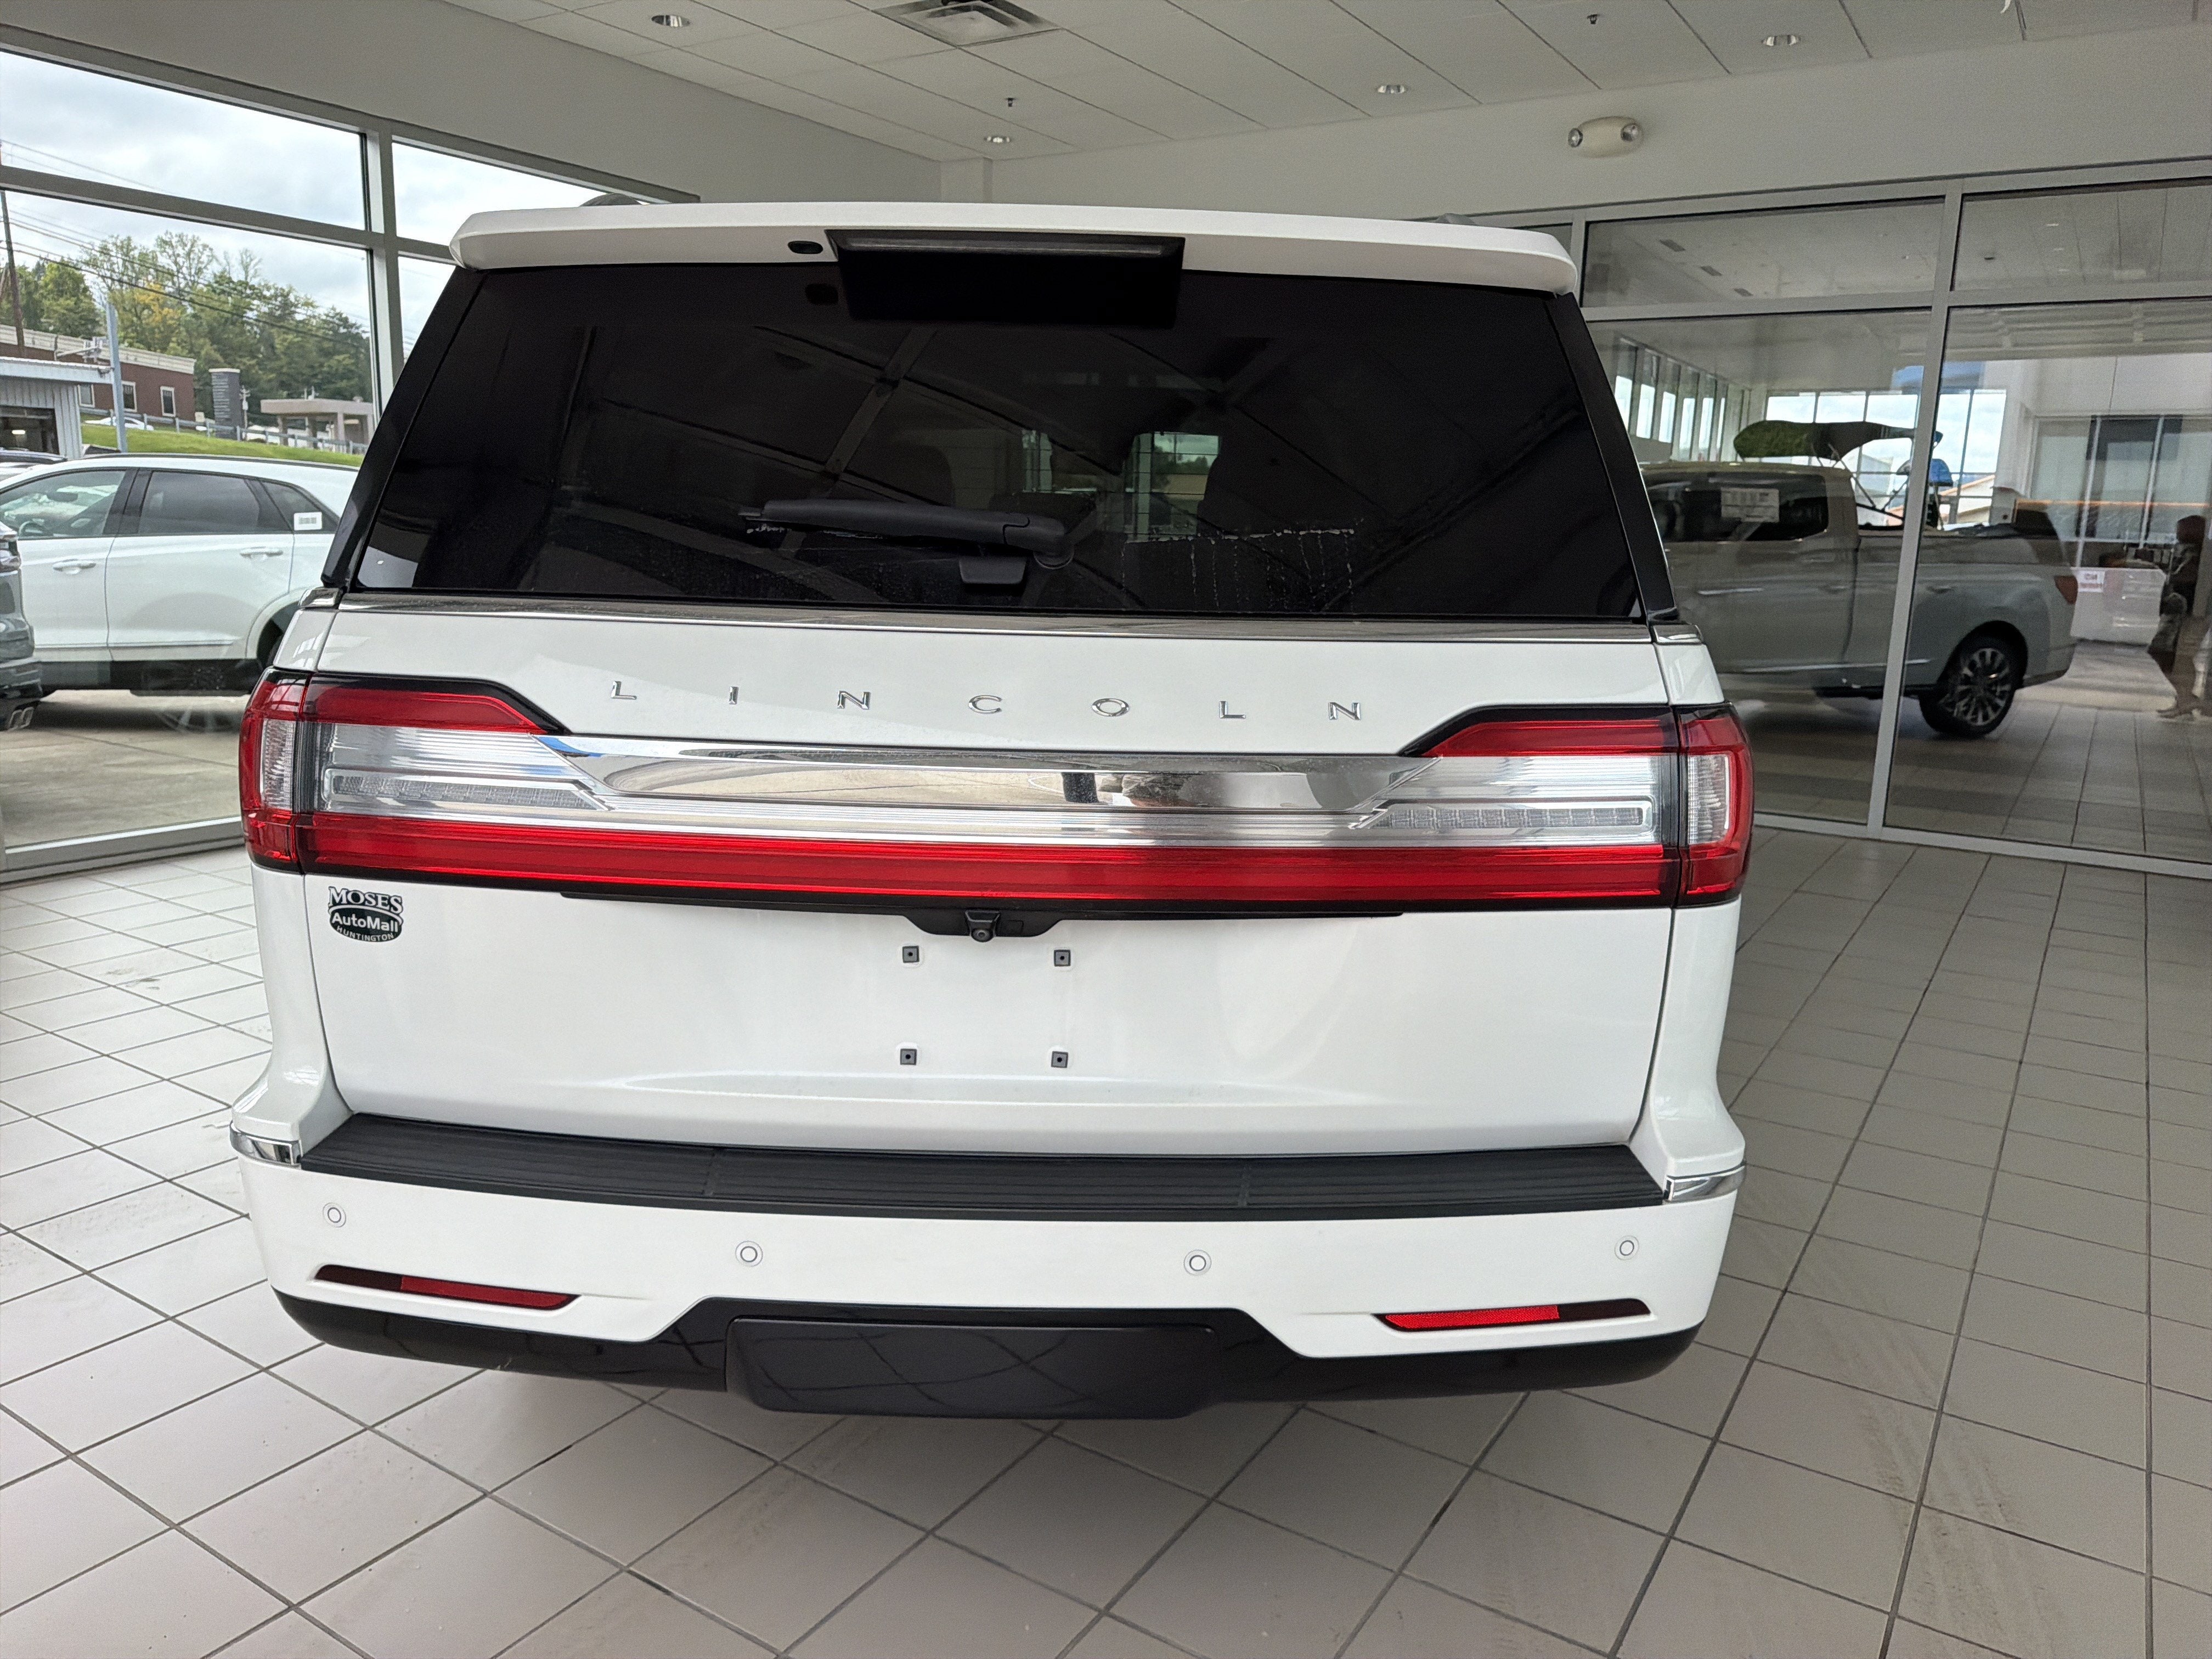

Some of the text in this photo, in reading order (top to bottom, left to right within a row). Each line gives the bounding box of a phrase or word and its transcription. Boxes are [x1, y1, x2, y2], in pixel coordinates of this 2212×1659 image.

[611, 680, 1361, 720] LINCOLN
[329, 887, 403, 914] MOSES
[331, 912, 398, 933] AutoMall
[336, 925, 394, 942] HUNTINGTON
